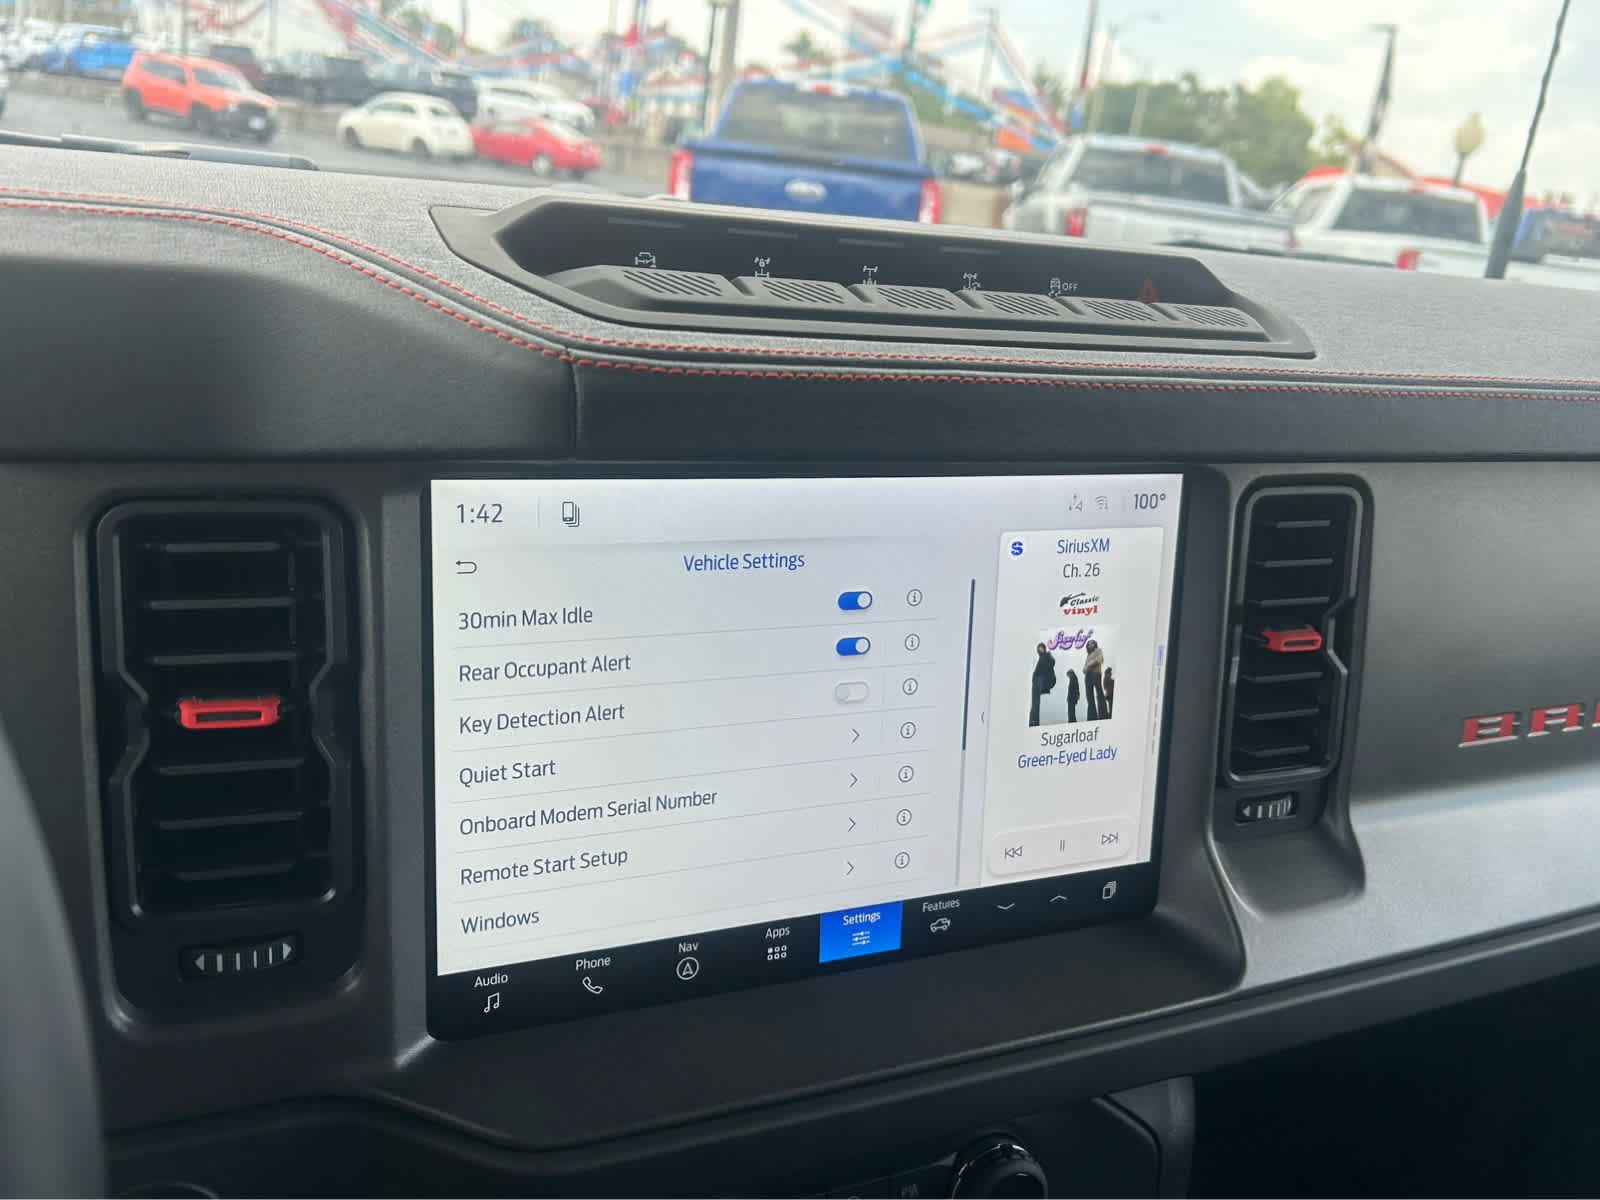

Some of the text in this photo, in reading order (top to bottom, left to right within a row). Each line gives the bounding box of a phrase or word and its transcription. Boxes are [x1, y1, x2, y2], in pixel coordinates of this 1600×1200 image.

[1062, 282, 1079, 291] OFF
[455, 503, 504, 524] 1:42
[1057, 537, 1110, 554] SiriusXM
[683, 552, 806, 572] Vehicle Settings
[1063, 562, 1101, 578] Ch. 26
[458, 606, 594, 630] 30min Max Idle
[458, 655, 632, 682] Rear Occupant Alert
[459, 703, 625, 735] Key Detection Alert
[1458, 701, 1600, 748] BR
[1041, 727, 1099, 747] Sugarloaf
[1018, 745, 1118, 769] Green-Eyed Lady
[459, 760, 556, 788] Quiet Start
[459, 790, 718, 836] Onboard Modem Serial Number
[460, 850, 629, 885] Remote Start Setup
[922, 897, 961, 913] Features
[460, 910, 541, 935] Windows
[842, 909, 881, 926] Settings
[765, 926, 791, 940] Apps
[678, 941, 699, 953] Nav
[575, 955, 612, 971] Phone
[474, 972, 509, 988] Audio
